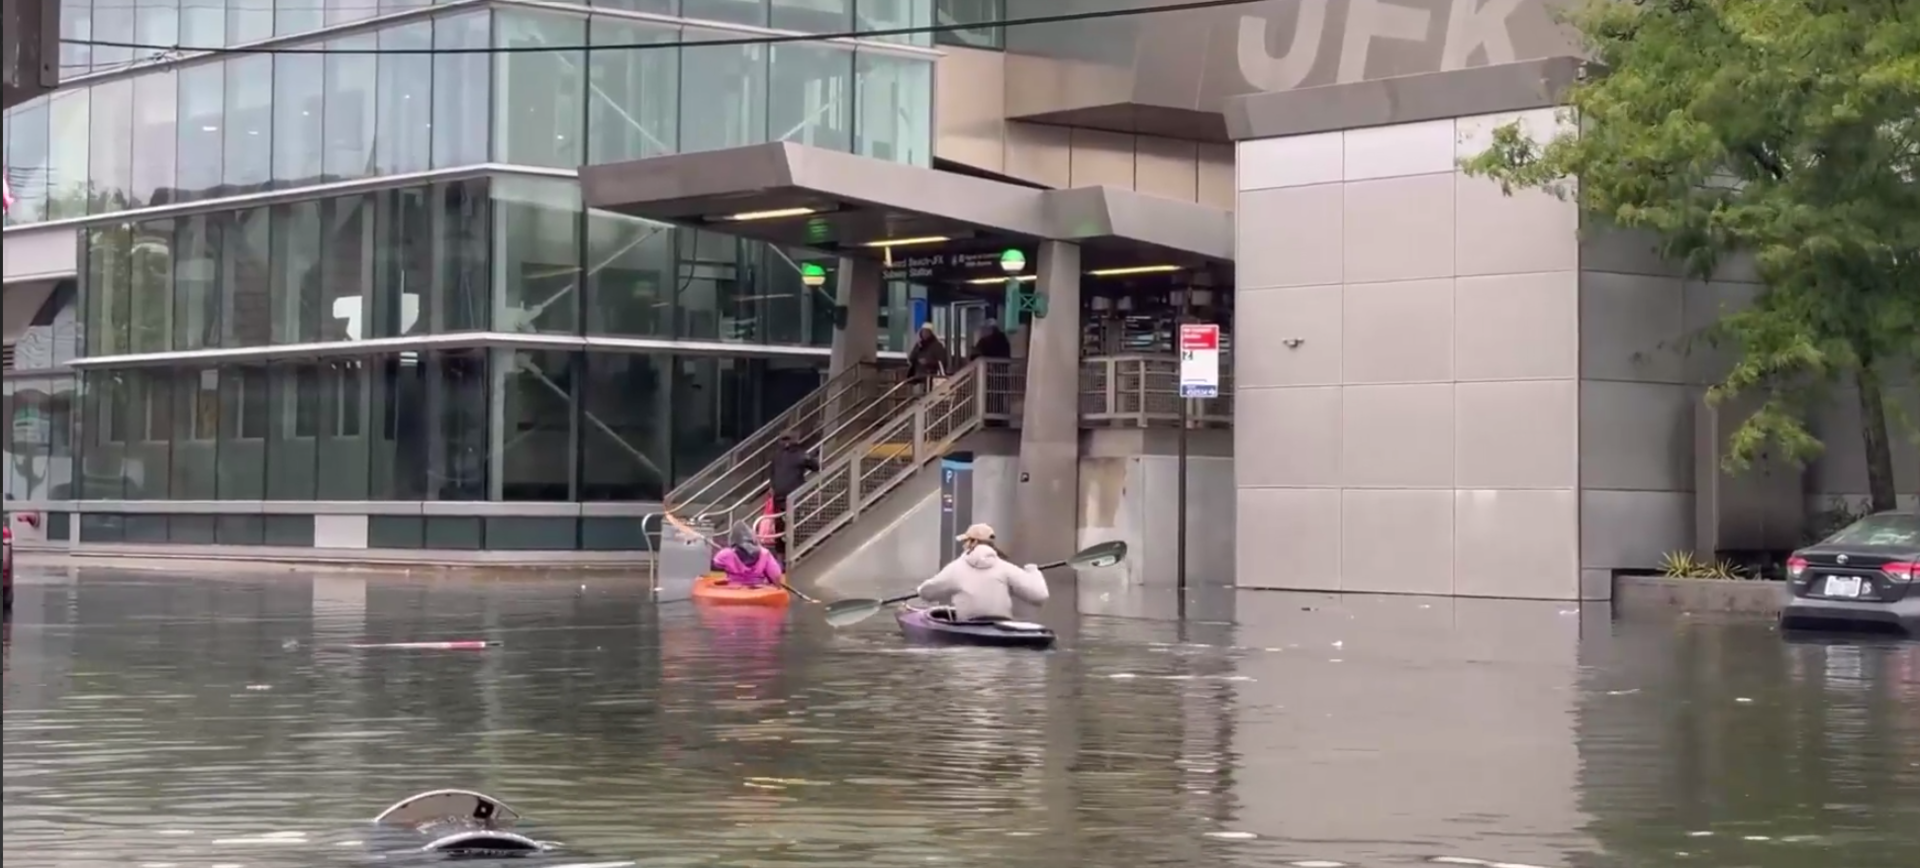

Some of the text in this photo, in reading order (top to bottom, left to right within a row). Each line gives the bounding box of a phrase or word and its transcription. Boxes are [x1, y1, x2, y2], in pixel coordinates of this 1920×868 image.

[1237, 0, 1517, 92] JFK
[883, 258, 907, 268] ward
[883, 267, 933, 279] Subway Station
[946, 470, 953, 483] P
